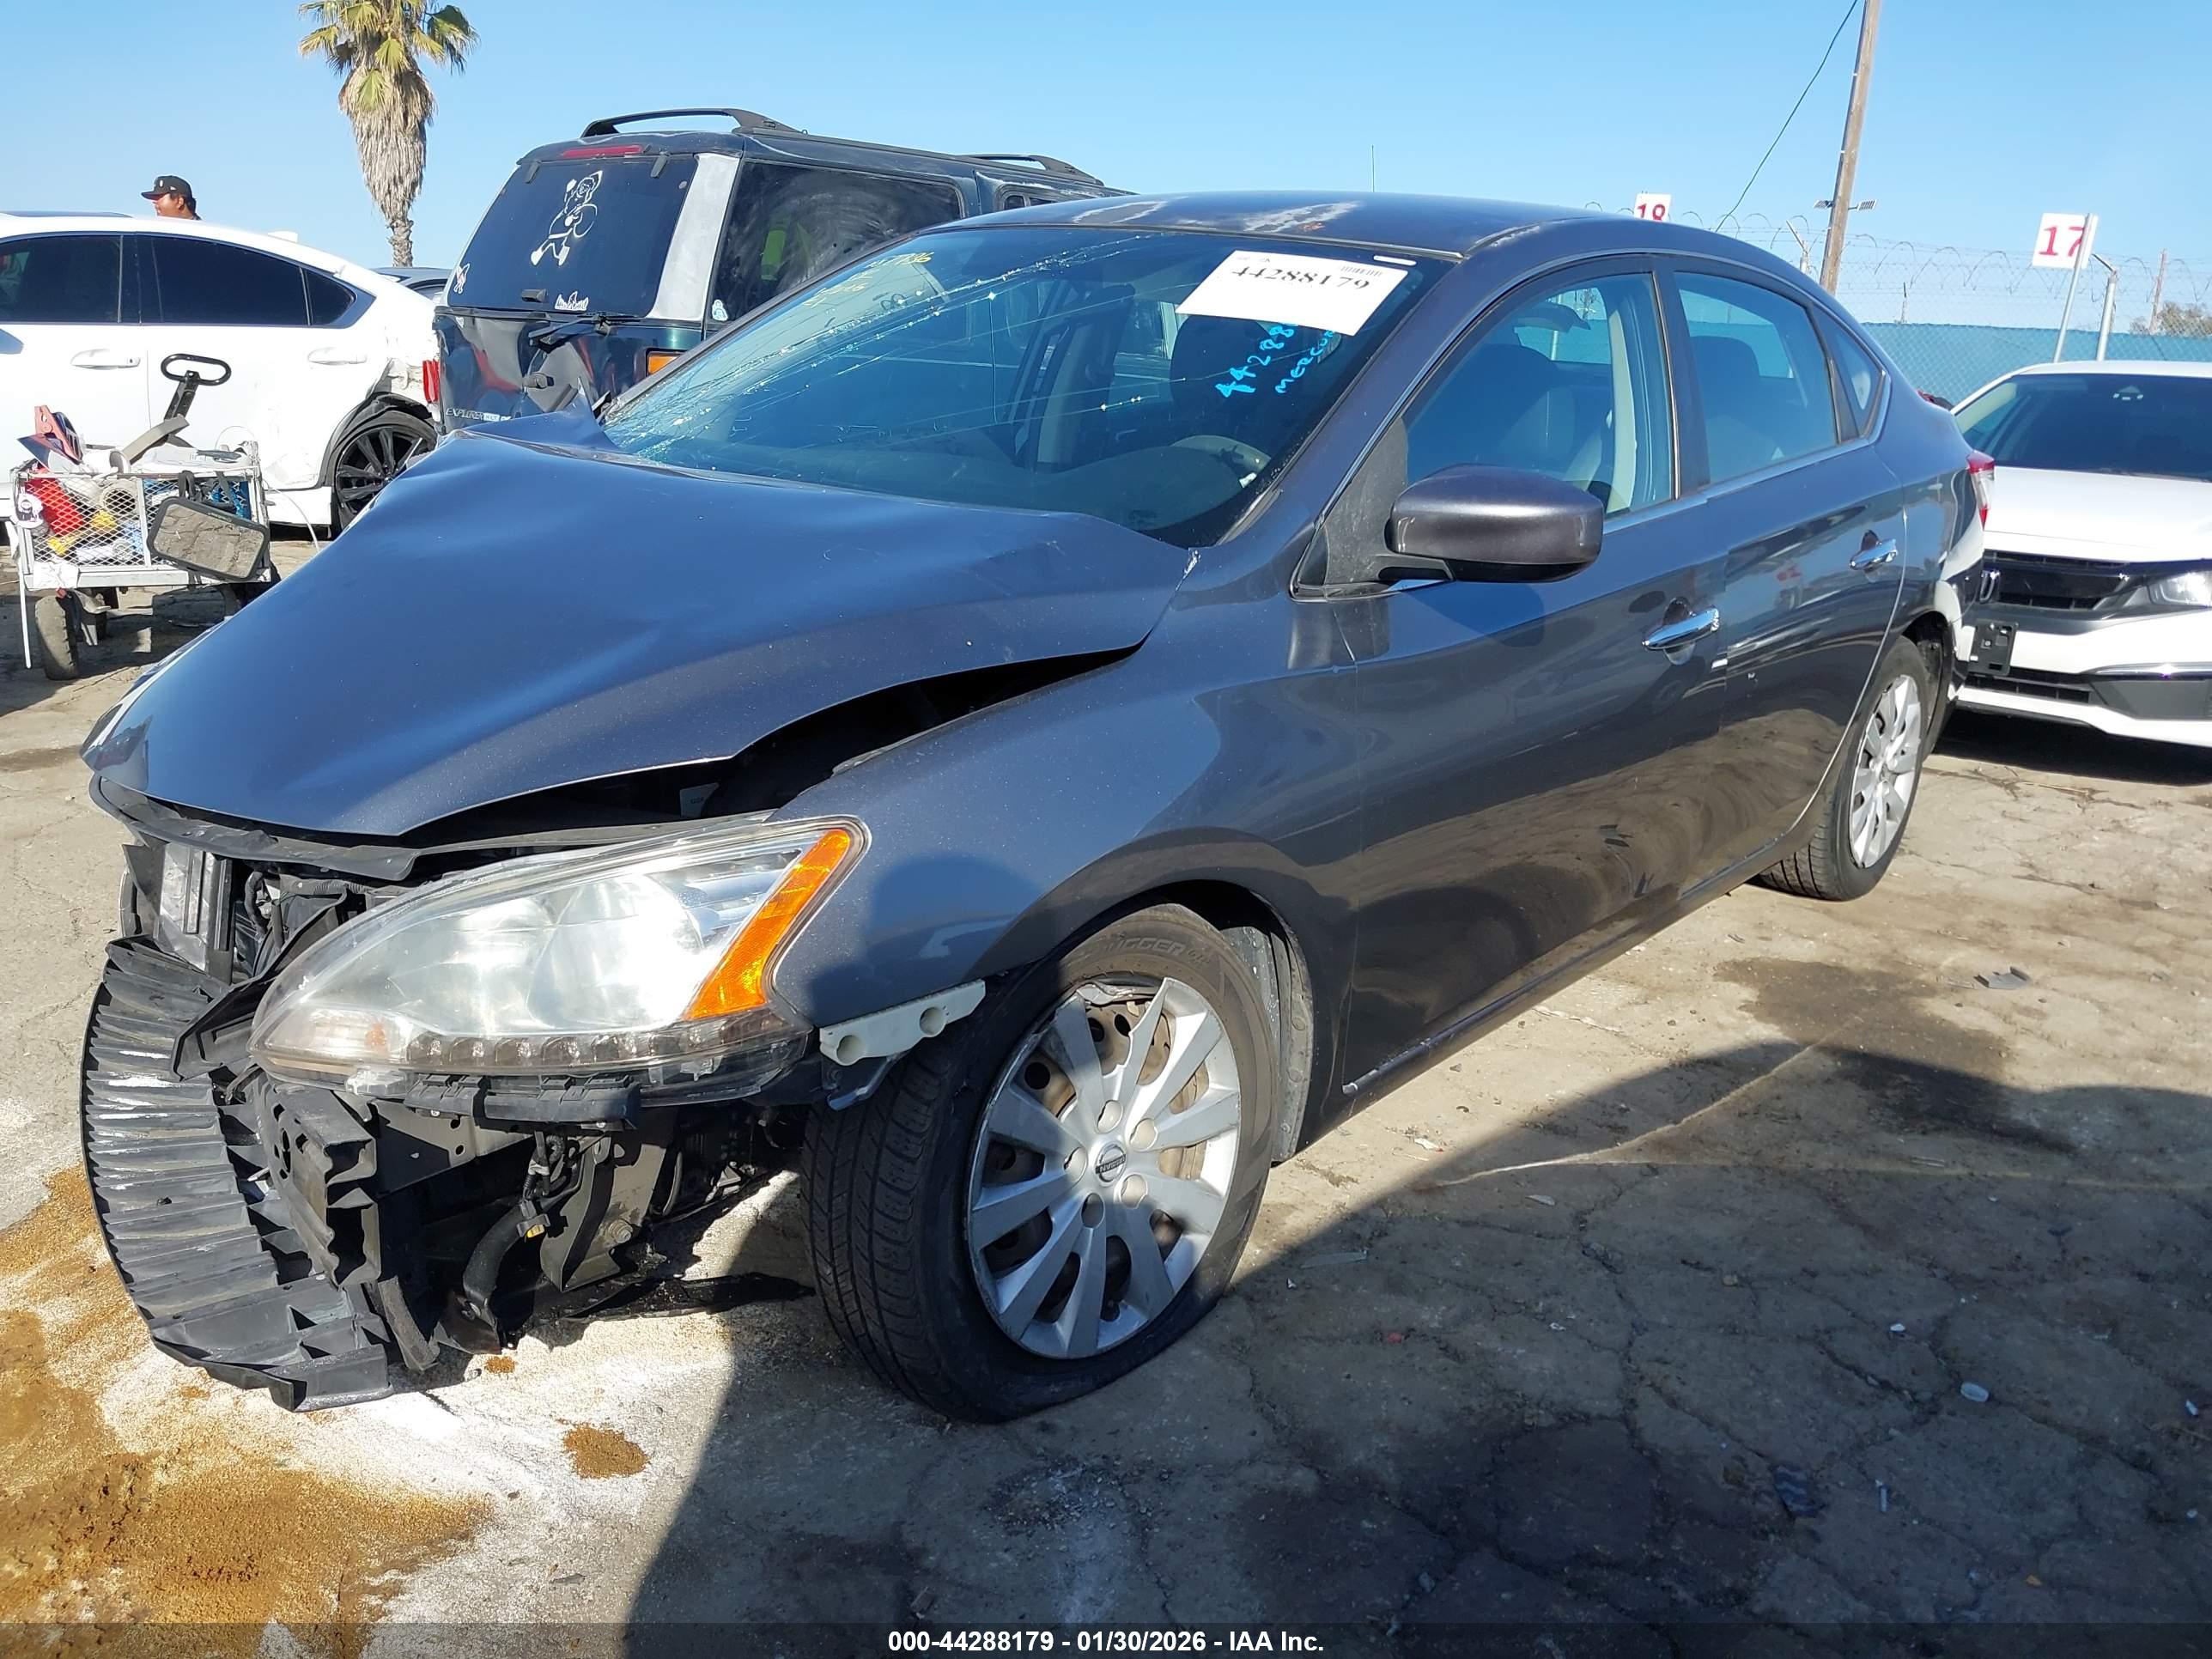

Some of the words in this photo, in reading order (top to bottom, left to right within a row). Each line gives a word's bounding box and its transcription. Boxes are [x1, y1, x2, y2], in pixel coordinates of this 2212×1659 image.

[2039, 225, 2085, 257] 17
[1231, 266, 1370, 289] 44288179
[1215, 322, 1298, 398] 44288
